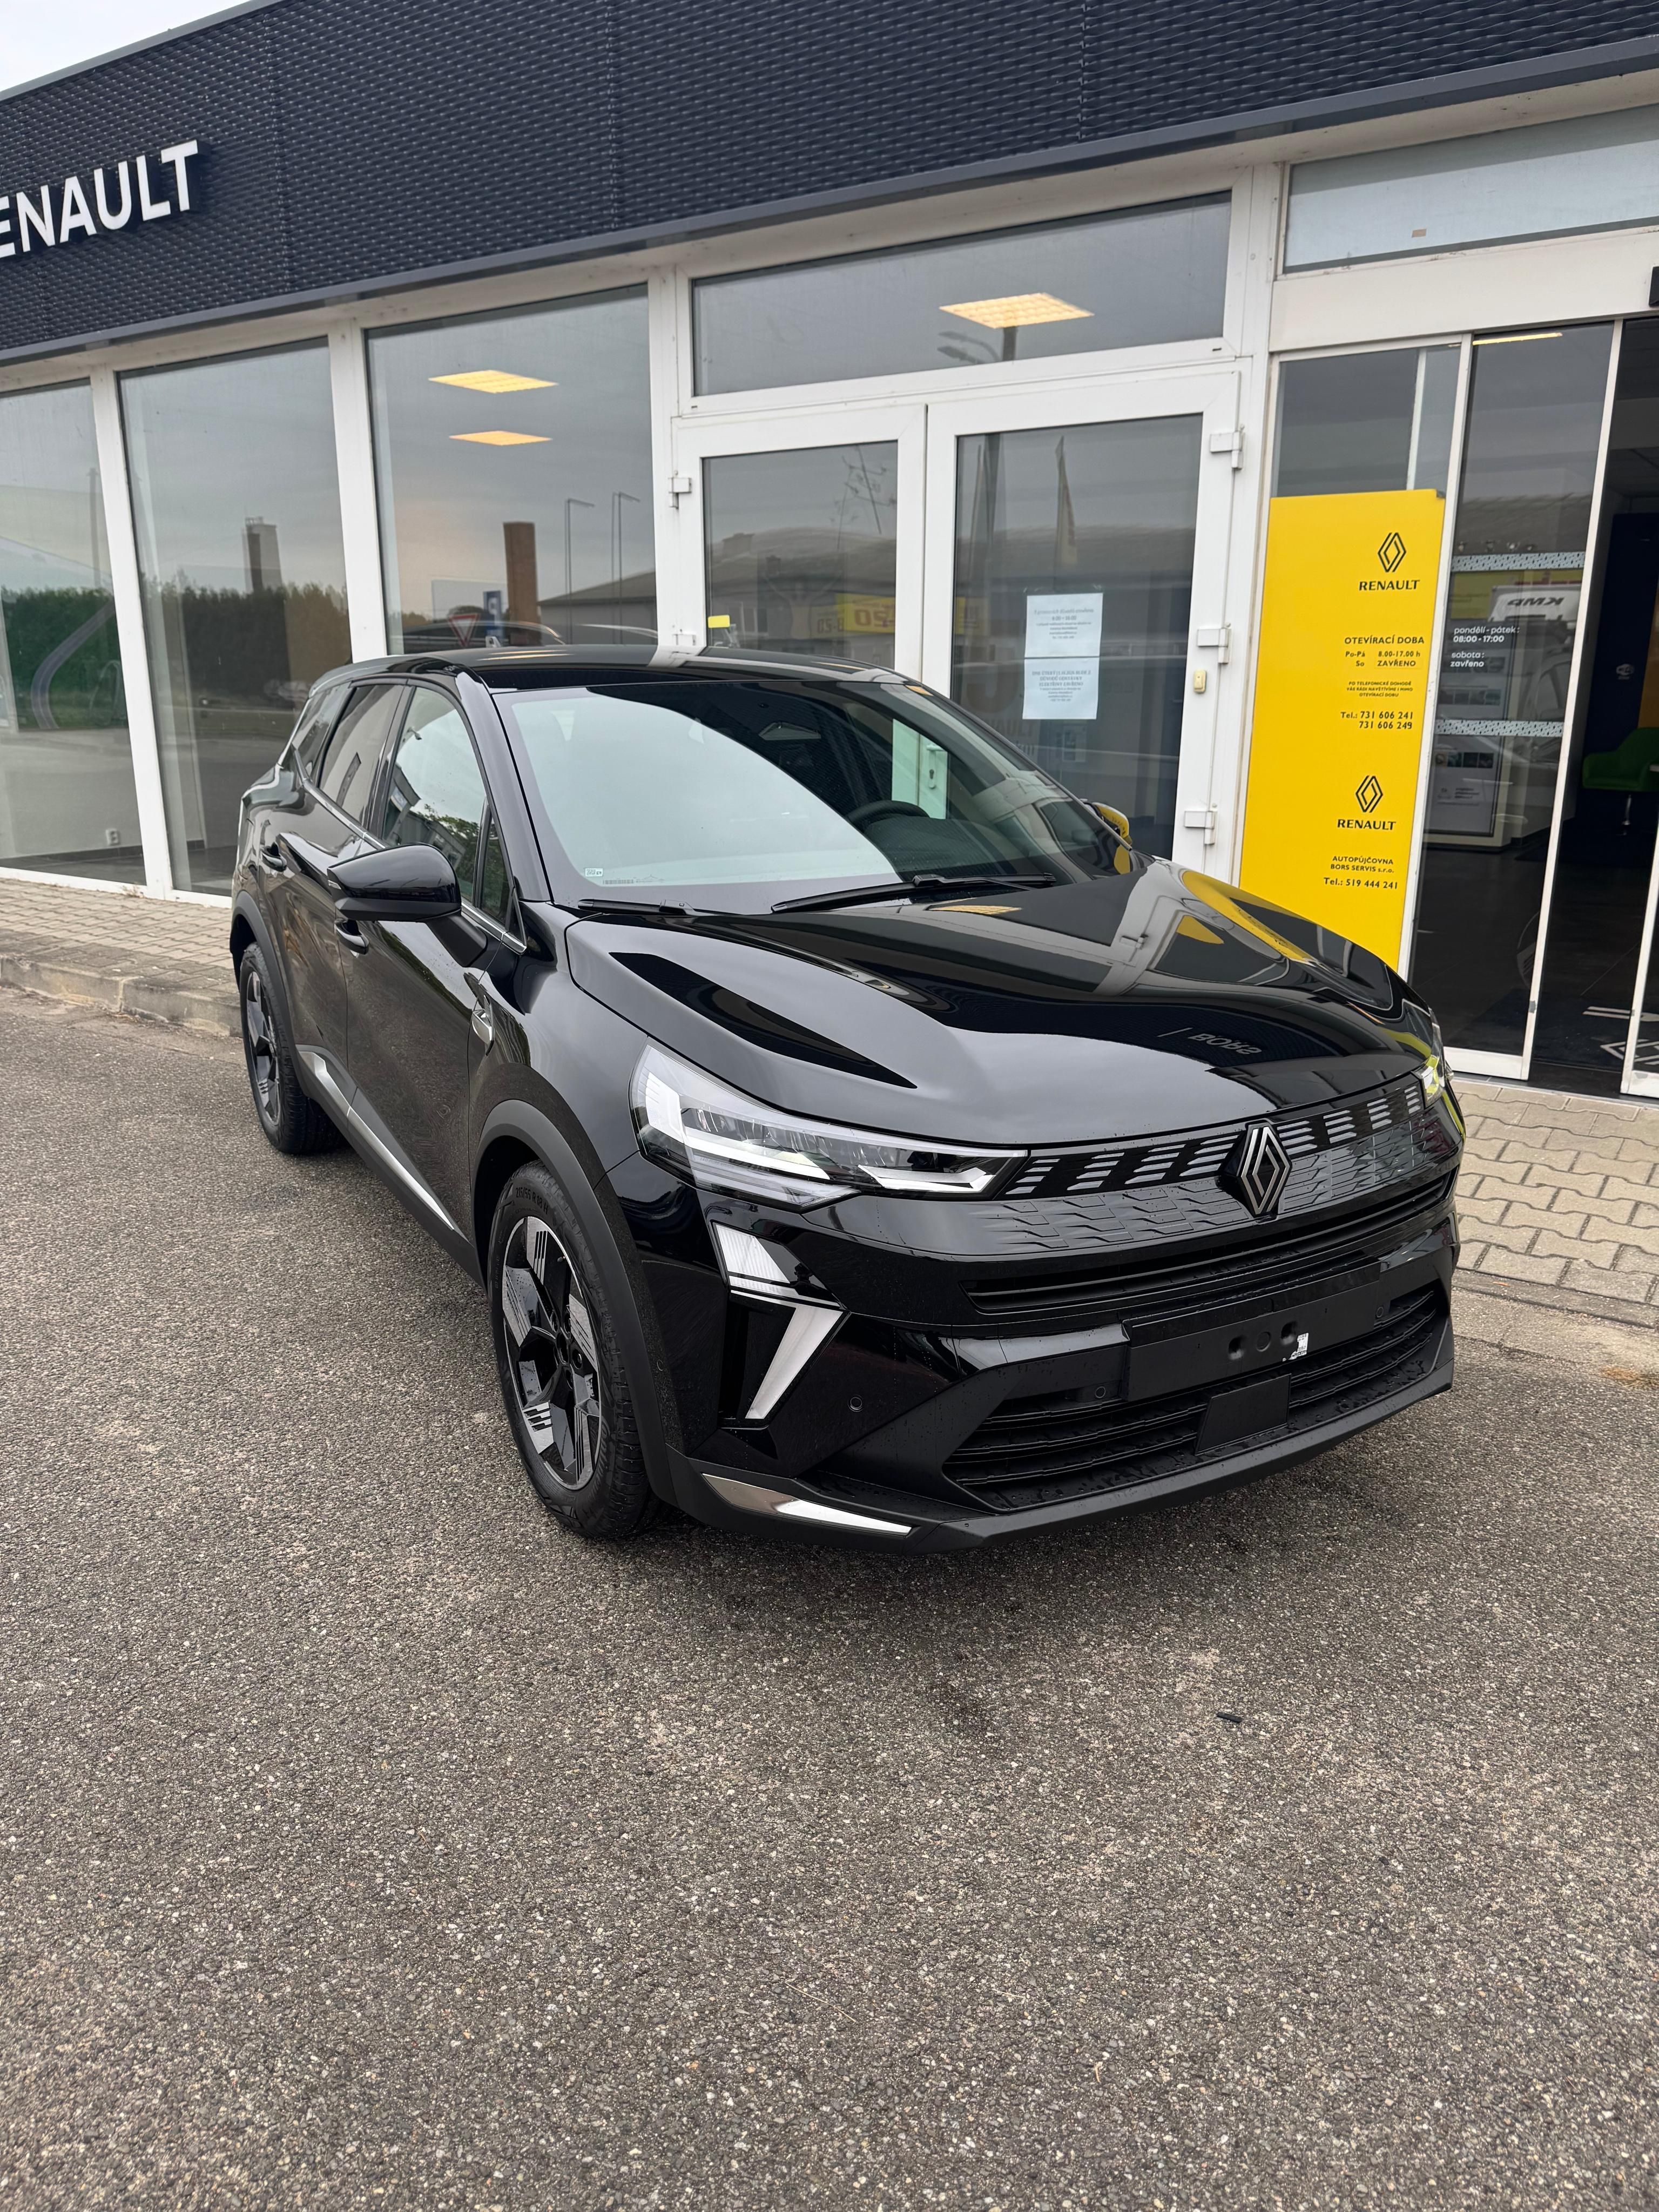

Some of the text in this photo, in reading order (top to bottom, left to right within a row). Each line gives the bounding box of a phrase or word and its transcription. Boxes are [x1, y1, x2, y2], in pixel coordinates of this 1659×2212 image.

[1359, 579, 1420, 591] RENAULT
[1454, 626, 1486, 635] pondělí
[1344, 635, 1425, 644] OTEVÍRACÍ DOBA
[1377, 658, 1416, 667] ZAVŘENO
[1450, 659, 1485, 667] zavřeno
[1360, 711, 1375, 719] 731
[1379, 711, 1394, 719] 606
[1378, 721, 1393, 729] 606
[1337, 819, 1396, 830] RENAULT
[1324, 877, 1343, 886] Tel.:
[1345, 879, 1361, 887] 519
[1383, 881, 1398, 889] 241
